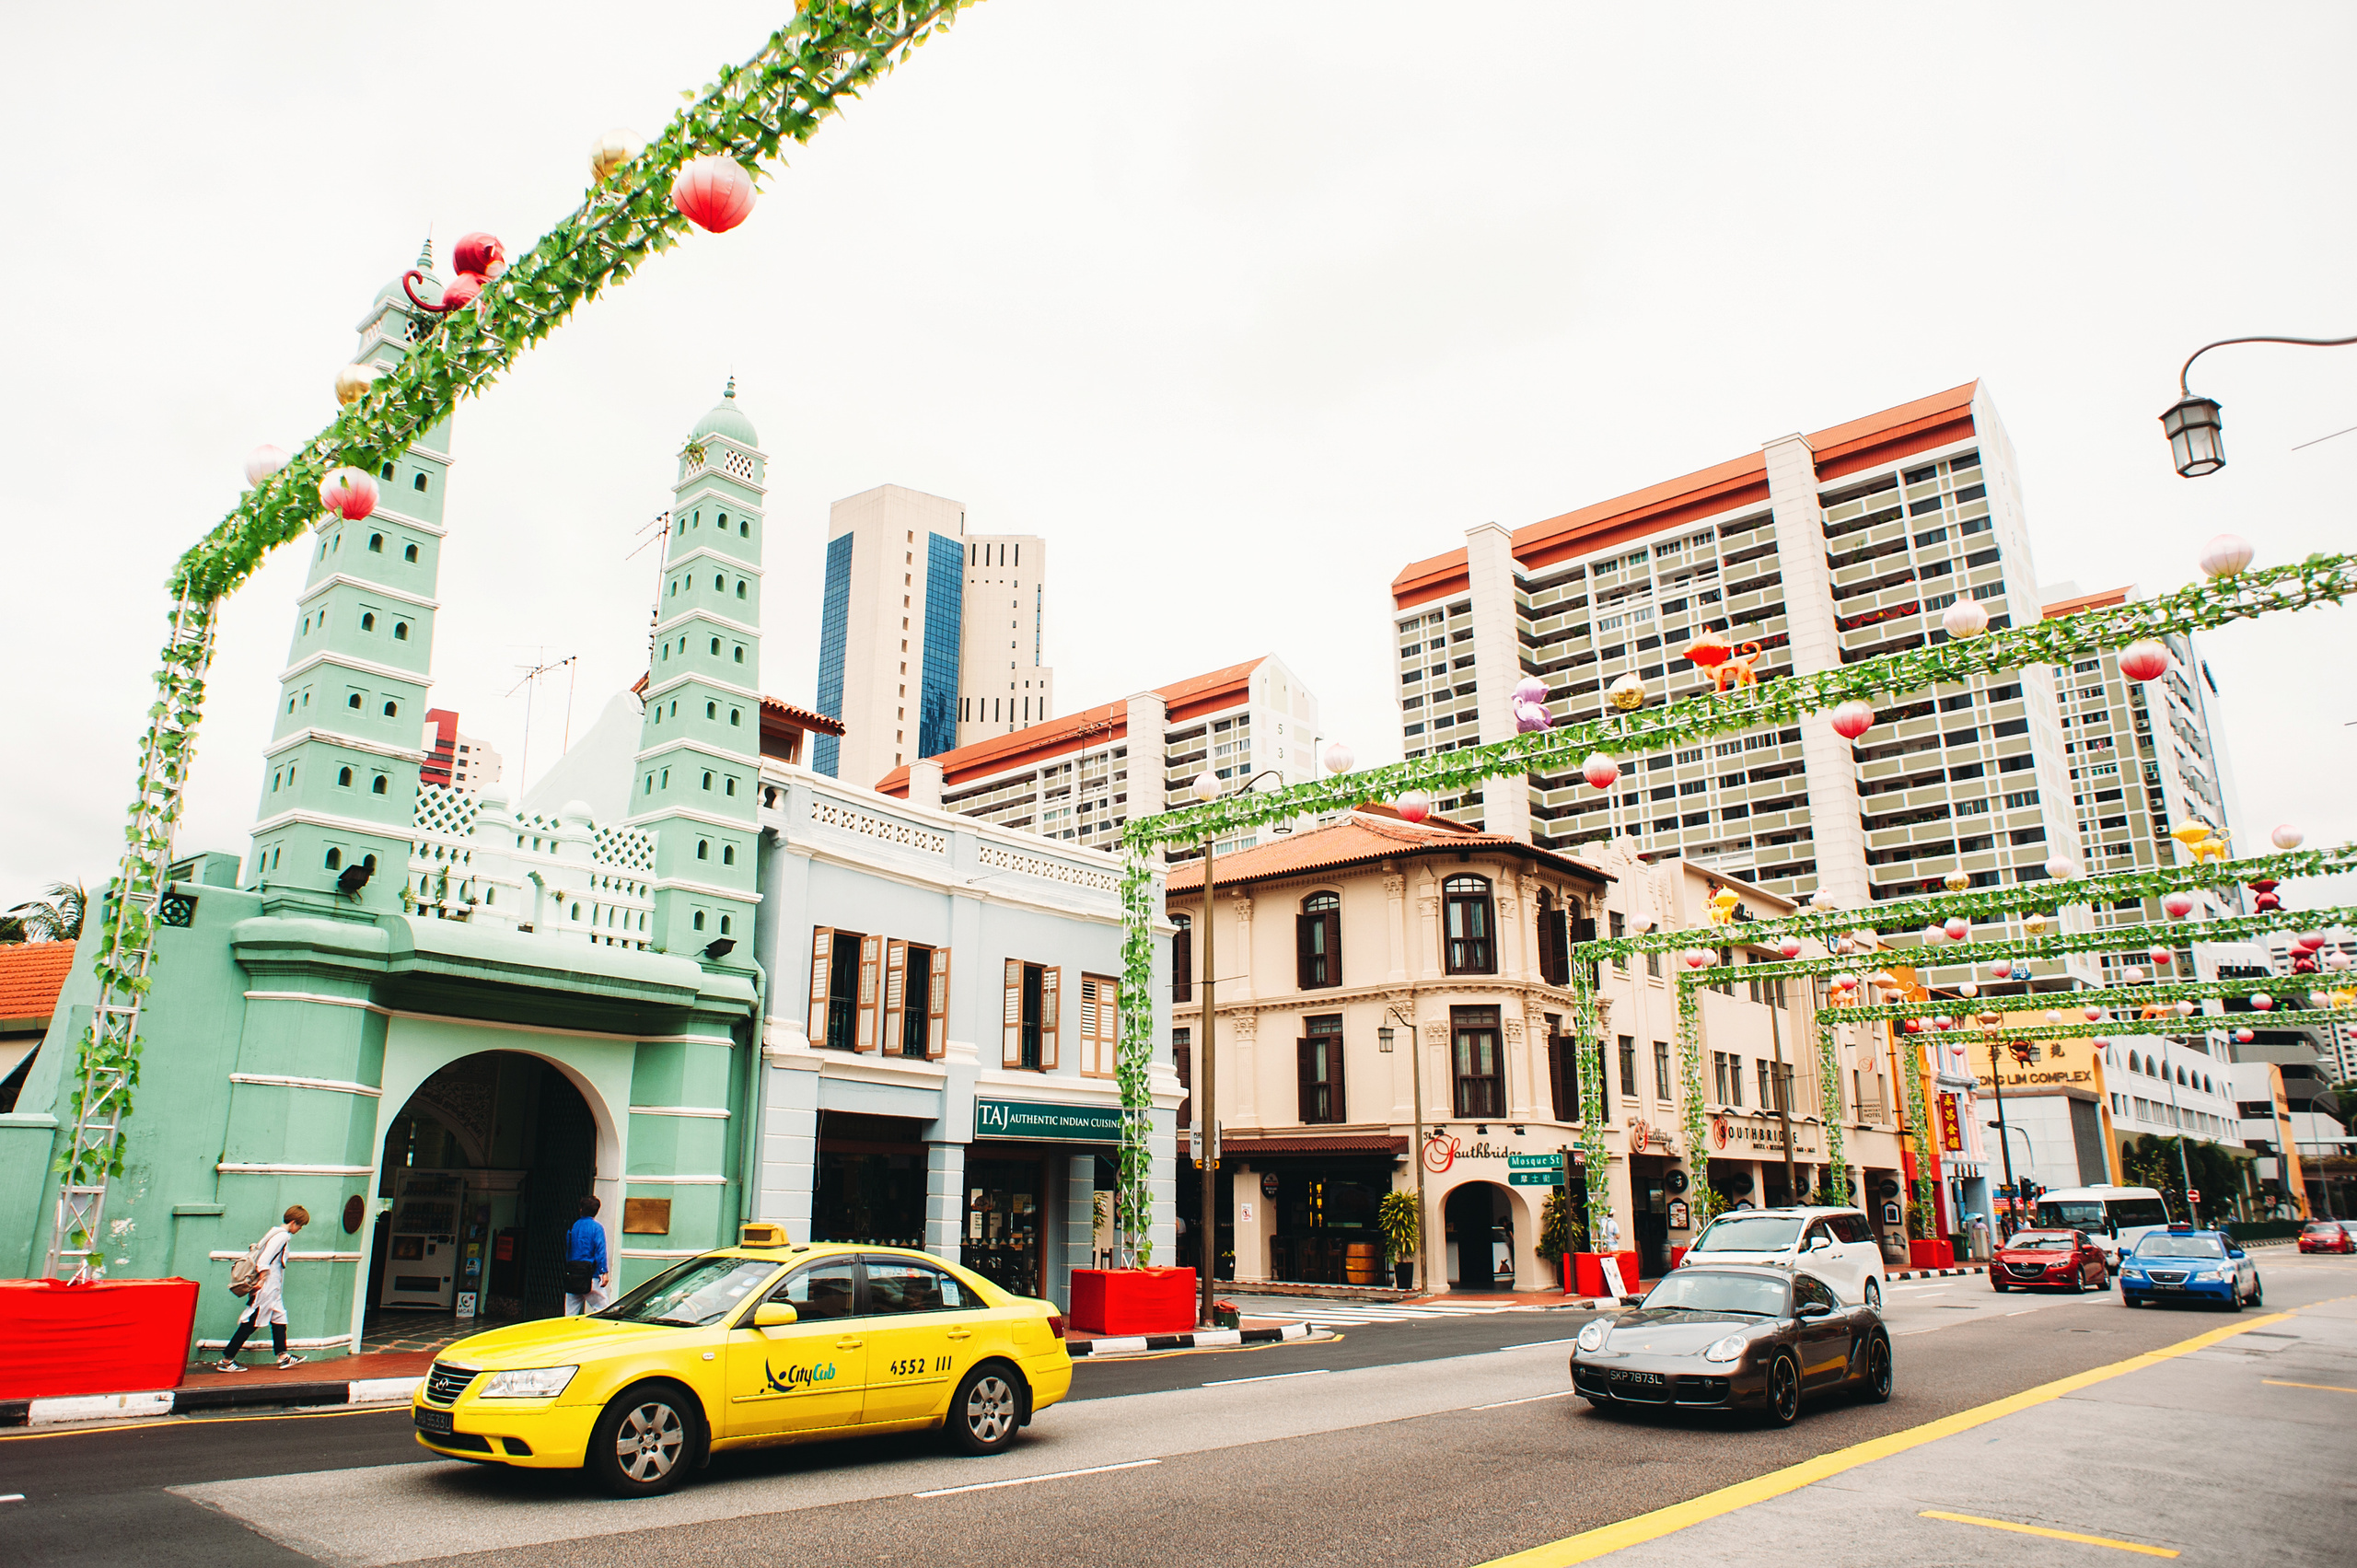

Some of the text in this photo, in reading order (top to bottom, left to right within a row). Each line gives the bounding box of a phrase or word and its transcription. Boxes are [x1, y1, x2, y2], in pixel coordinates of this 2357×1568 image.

[1976, 1071, 2092, 1086] ONG LIM COMPLEX
[980, 1105, 1009, 1131] TAJ
[1010, 1113, 1058, 1126] AUTHENTIC
[1060, 1116, 1089, 1127] INDIAN
[1719, 1125, 1798, 1144] SOUTHBRIDE
[1511, 1155, 1561, 1167] Mosque St
